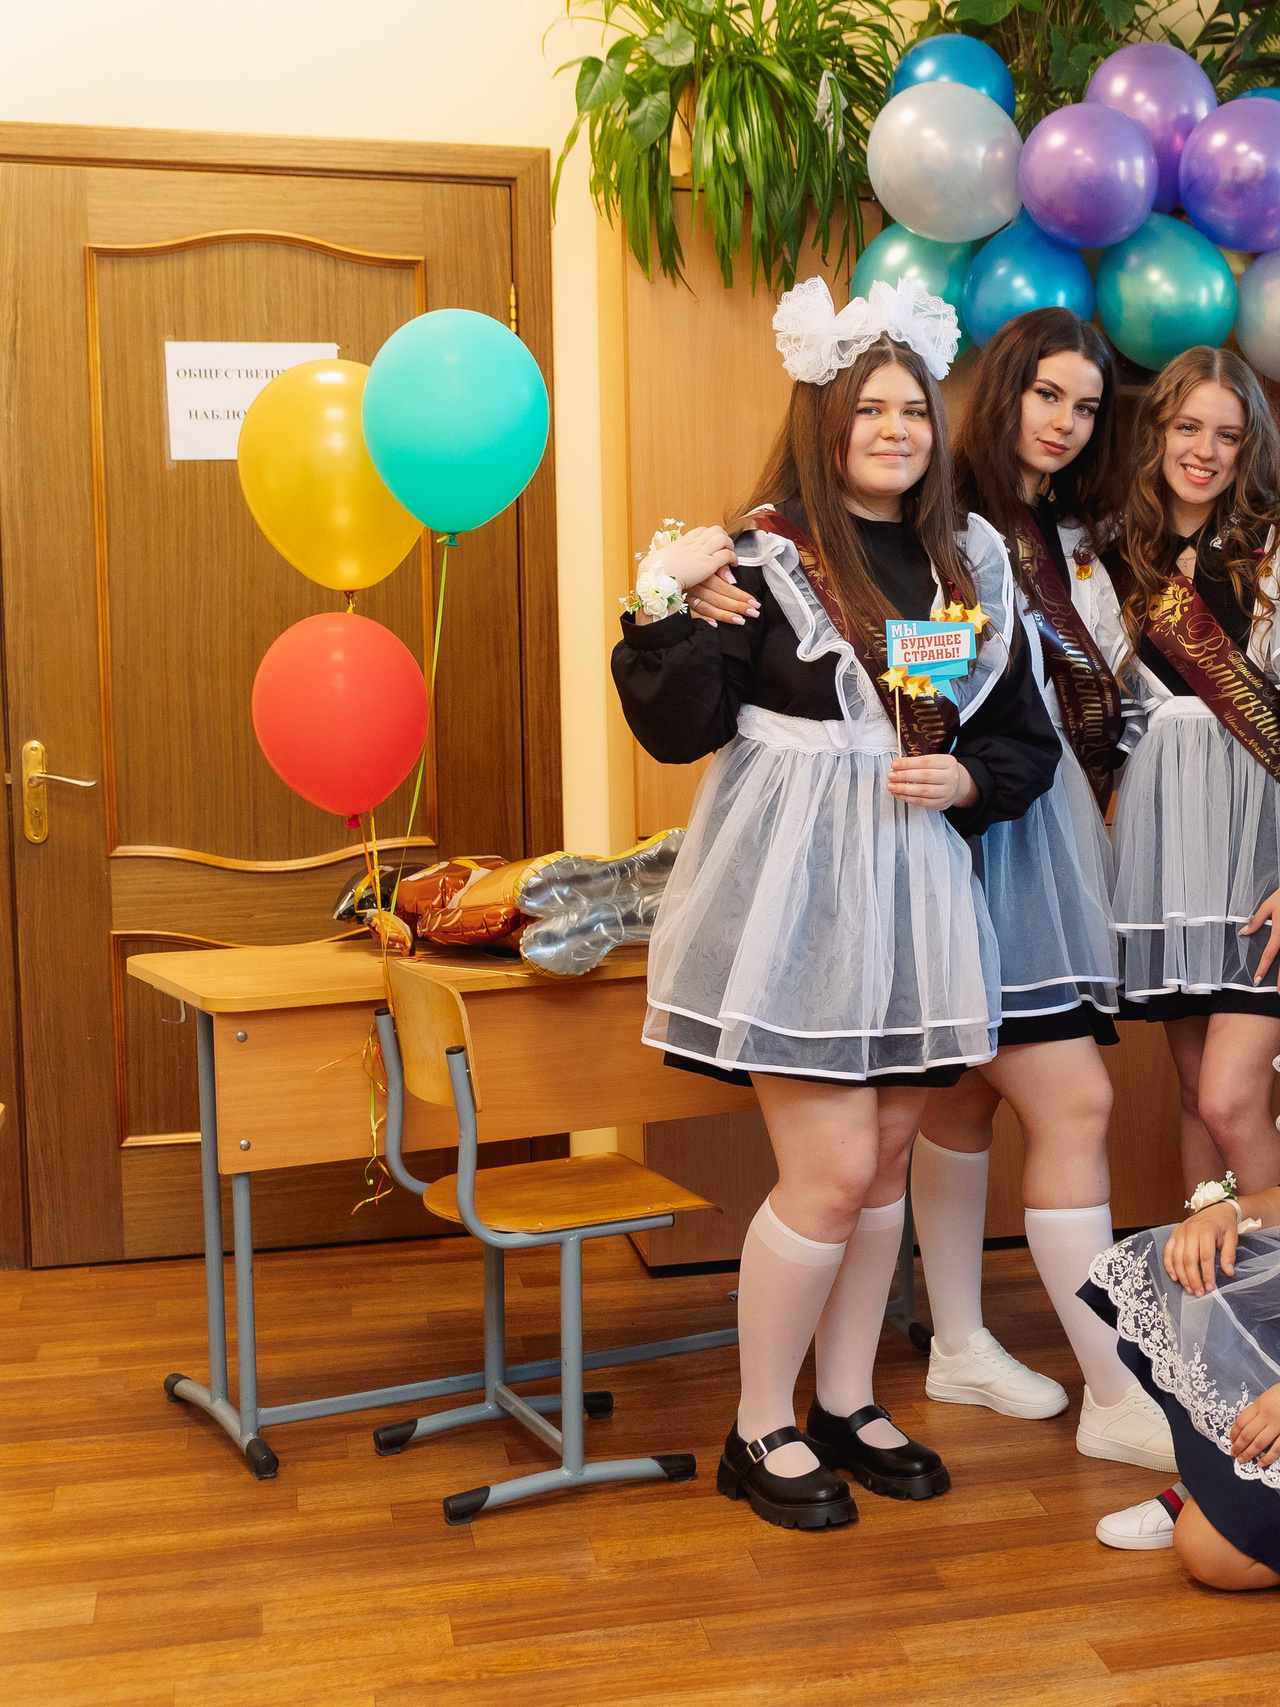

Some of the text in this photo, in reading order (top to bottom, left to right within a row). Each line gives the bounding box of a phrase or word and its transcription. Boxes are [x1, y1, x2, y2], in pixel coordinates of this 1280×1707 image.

[890, 622, 918, 638] МЫ
[900, 633, 962, 650] БУДУЩЕЕ
[903, 647, 960, 663] СТРАНЫ!
[1036, 575, 1103, 738] Выпускница
[1228, 650, 1264, 690] Тарасова
[1099, 672, 1114, 717] Екатерина
[1222, 709, 1246, 738] Школа
[1244, 737, 1267, 759] №422
